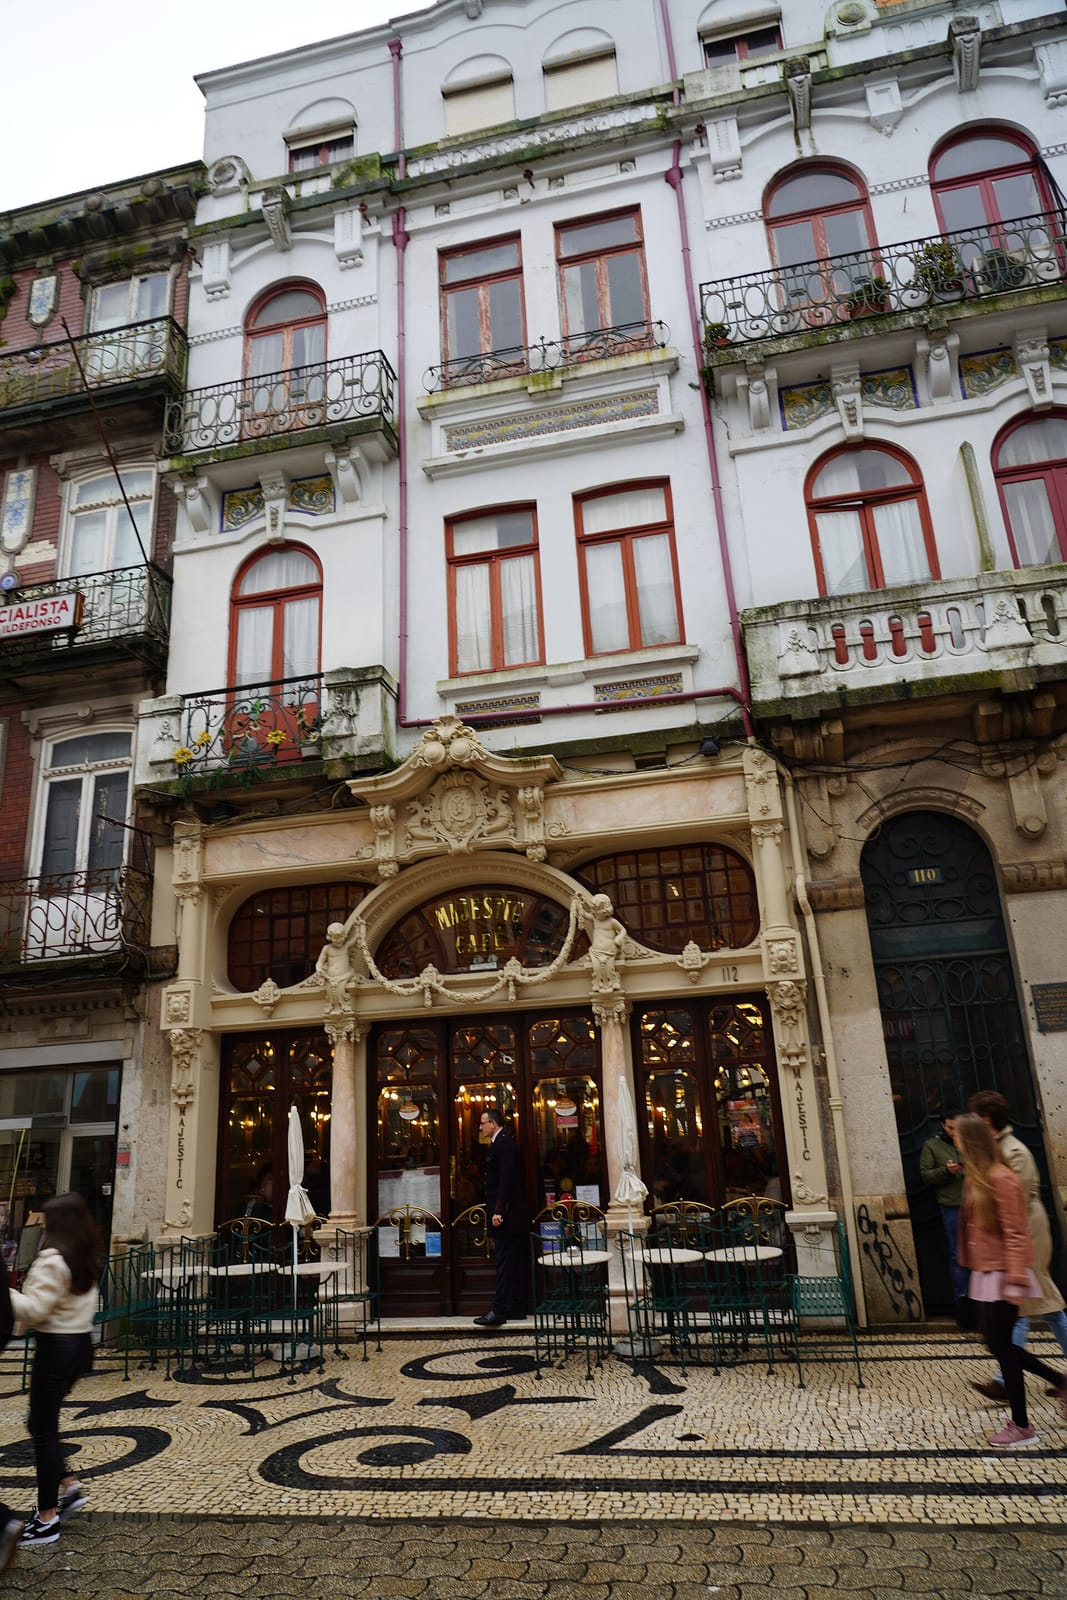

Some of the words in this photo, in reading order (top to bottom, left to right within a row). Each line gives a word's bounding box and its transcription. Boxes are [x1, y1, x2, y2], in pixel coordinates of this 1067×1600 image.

[2, 616, 62, 633] ILDEFONSO
[914, 868, 936, 882] 110
[722, 966, 739, 982] 112
[792, 1067, 811, 1161] MAJESTIC
[176, 1105, 186, 1190] MAJESTIC
